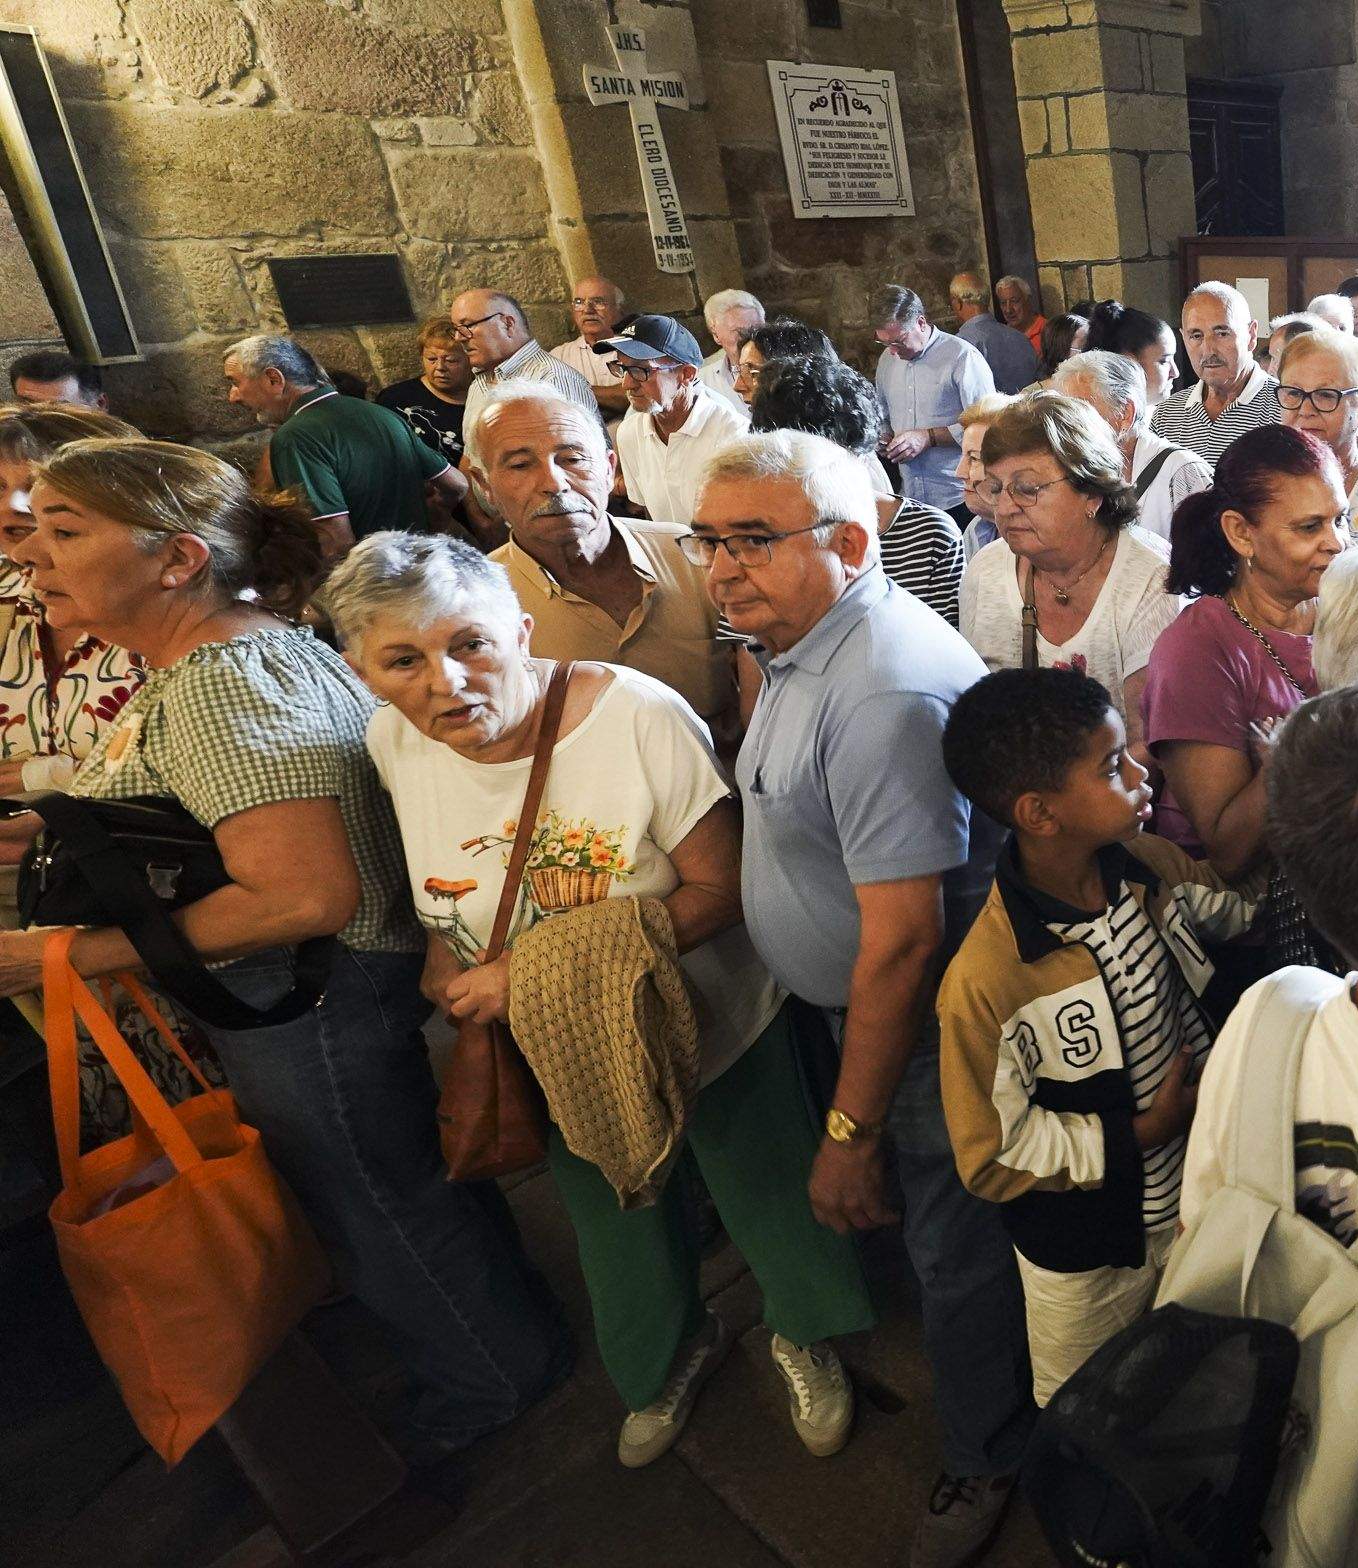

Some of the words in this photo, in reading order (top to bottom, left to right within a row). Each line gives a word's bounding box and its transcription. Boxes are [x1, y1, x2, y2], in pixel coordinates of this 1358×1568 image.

[590, 76, 636, 96] SANTA
[640, 79, 684, 98] MISION
[638, 123, 662, 163] CLERO
[651, 167, 683, 233] DIOCESANO
